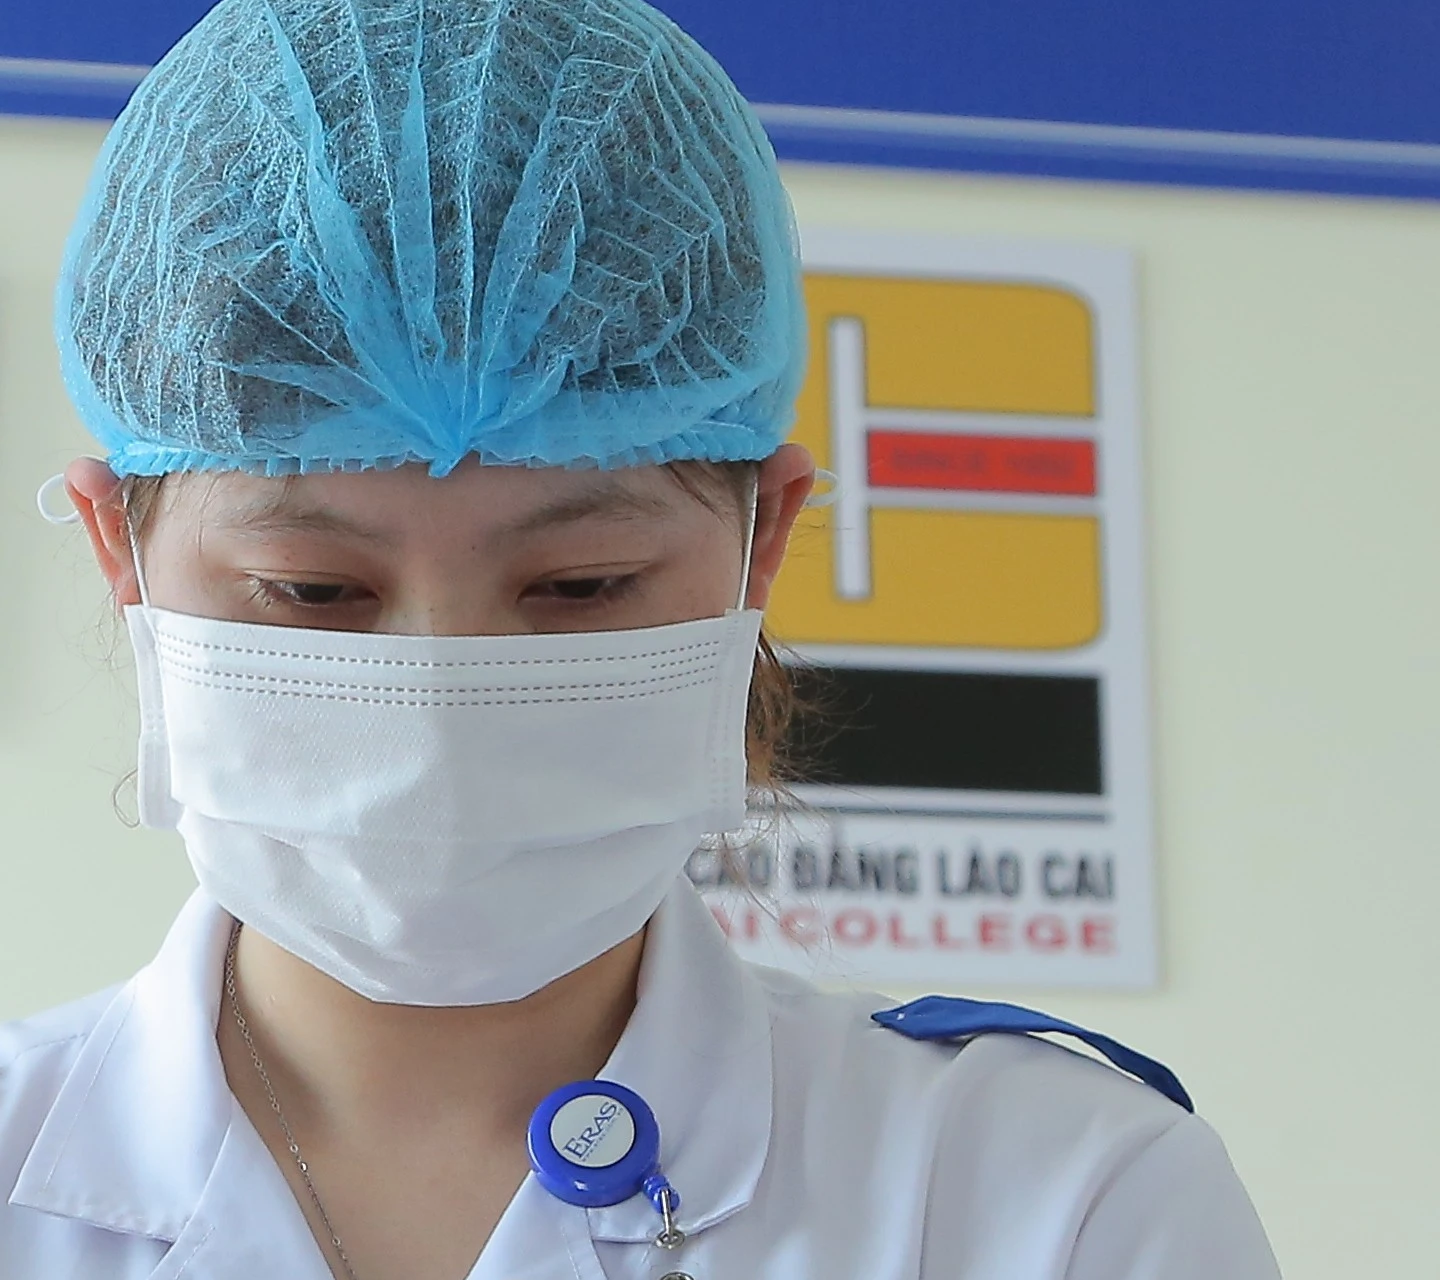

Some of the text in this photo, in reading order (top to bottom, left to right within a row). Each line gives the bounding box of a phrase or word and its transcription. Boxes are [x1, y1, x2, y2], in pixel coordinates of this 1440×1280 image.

[1041, 852, 1114, 902] CAI
[779, 906, 1117, 954] COLLEGE
[563, 1101, 617, 1158] ERAS
